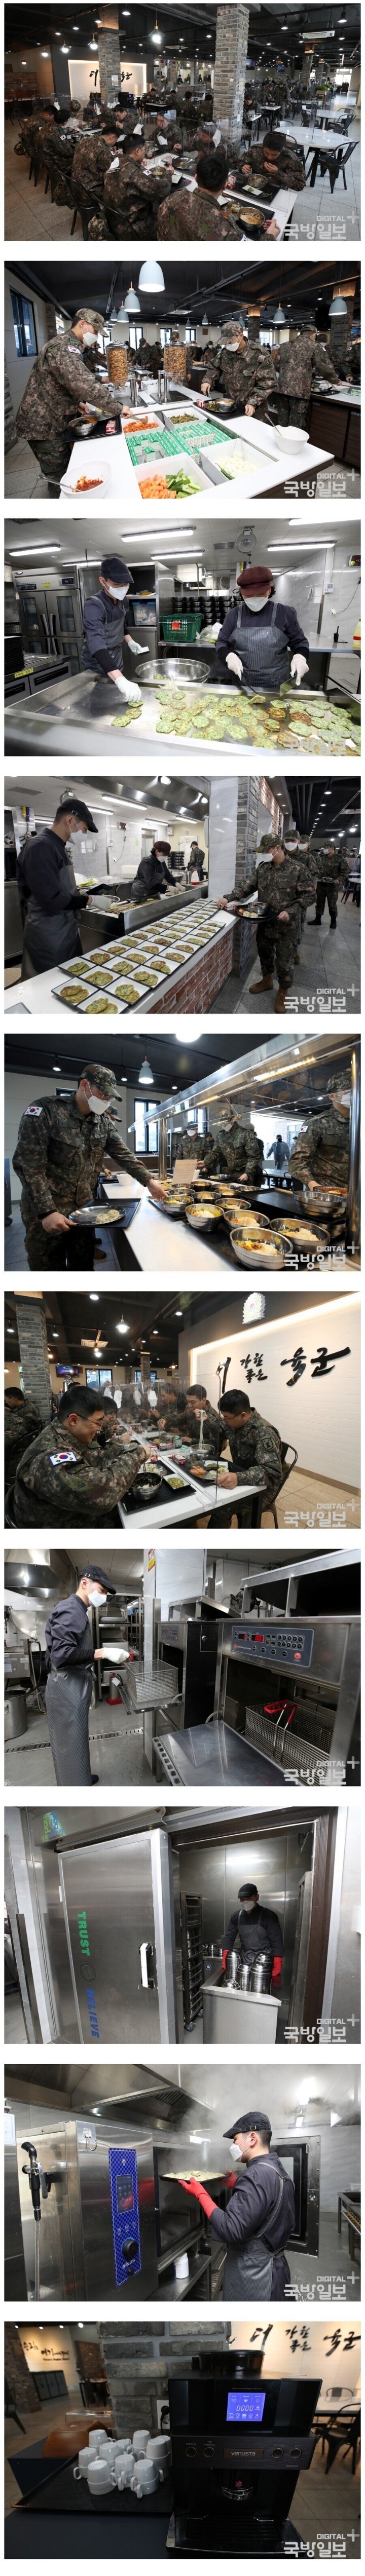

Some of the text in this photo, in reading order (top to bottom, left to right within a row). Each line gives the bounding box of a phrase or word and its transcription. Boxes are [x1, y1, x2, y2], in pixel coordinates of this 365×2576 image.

[240, 1352, 264, 1369] 강한
[280, 1347, 351, 1386] 육군
[245, 1369, 268, 1384] 좋은
[77, 1911, 90, 1956] TRUST
[86, 1988, 100, 2039] BELIEVE
[250, 2324, 361, 2357] 더 강한 육군
[290, 2339, 312, 2354] 좋은
